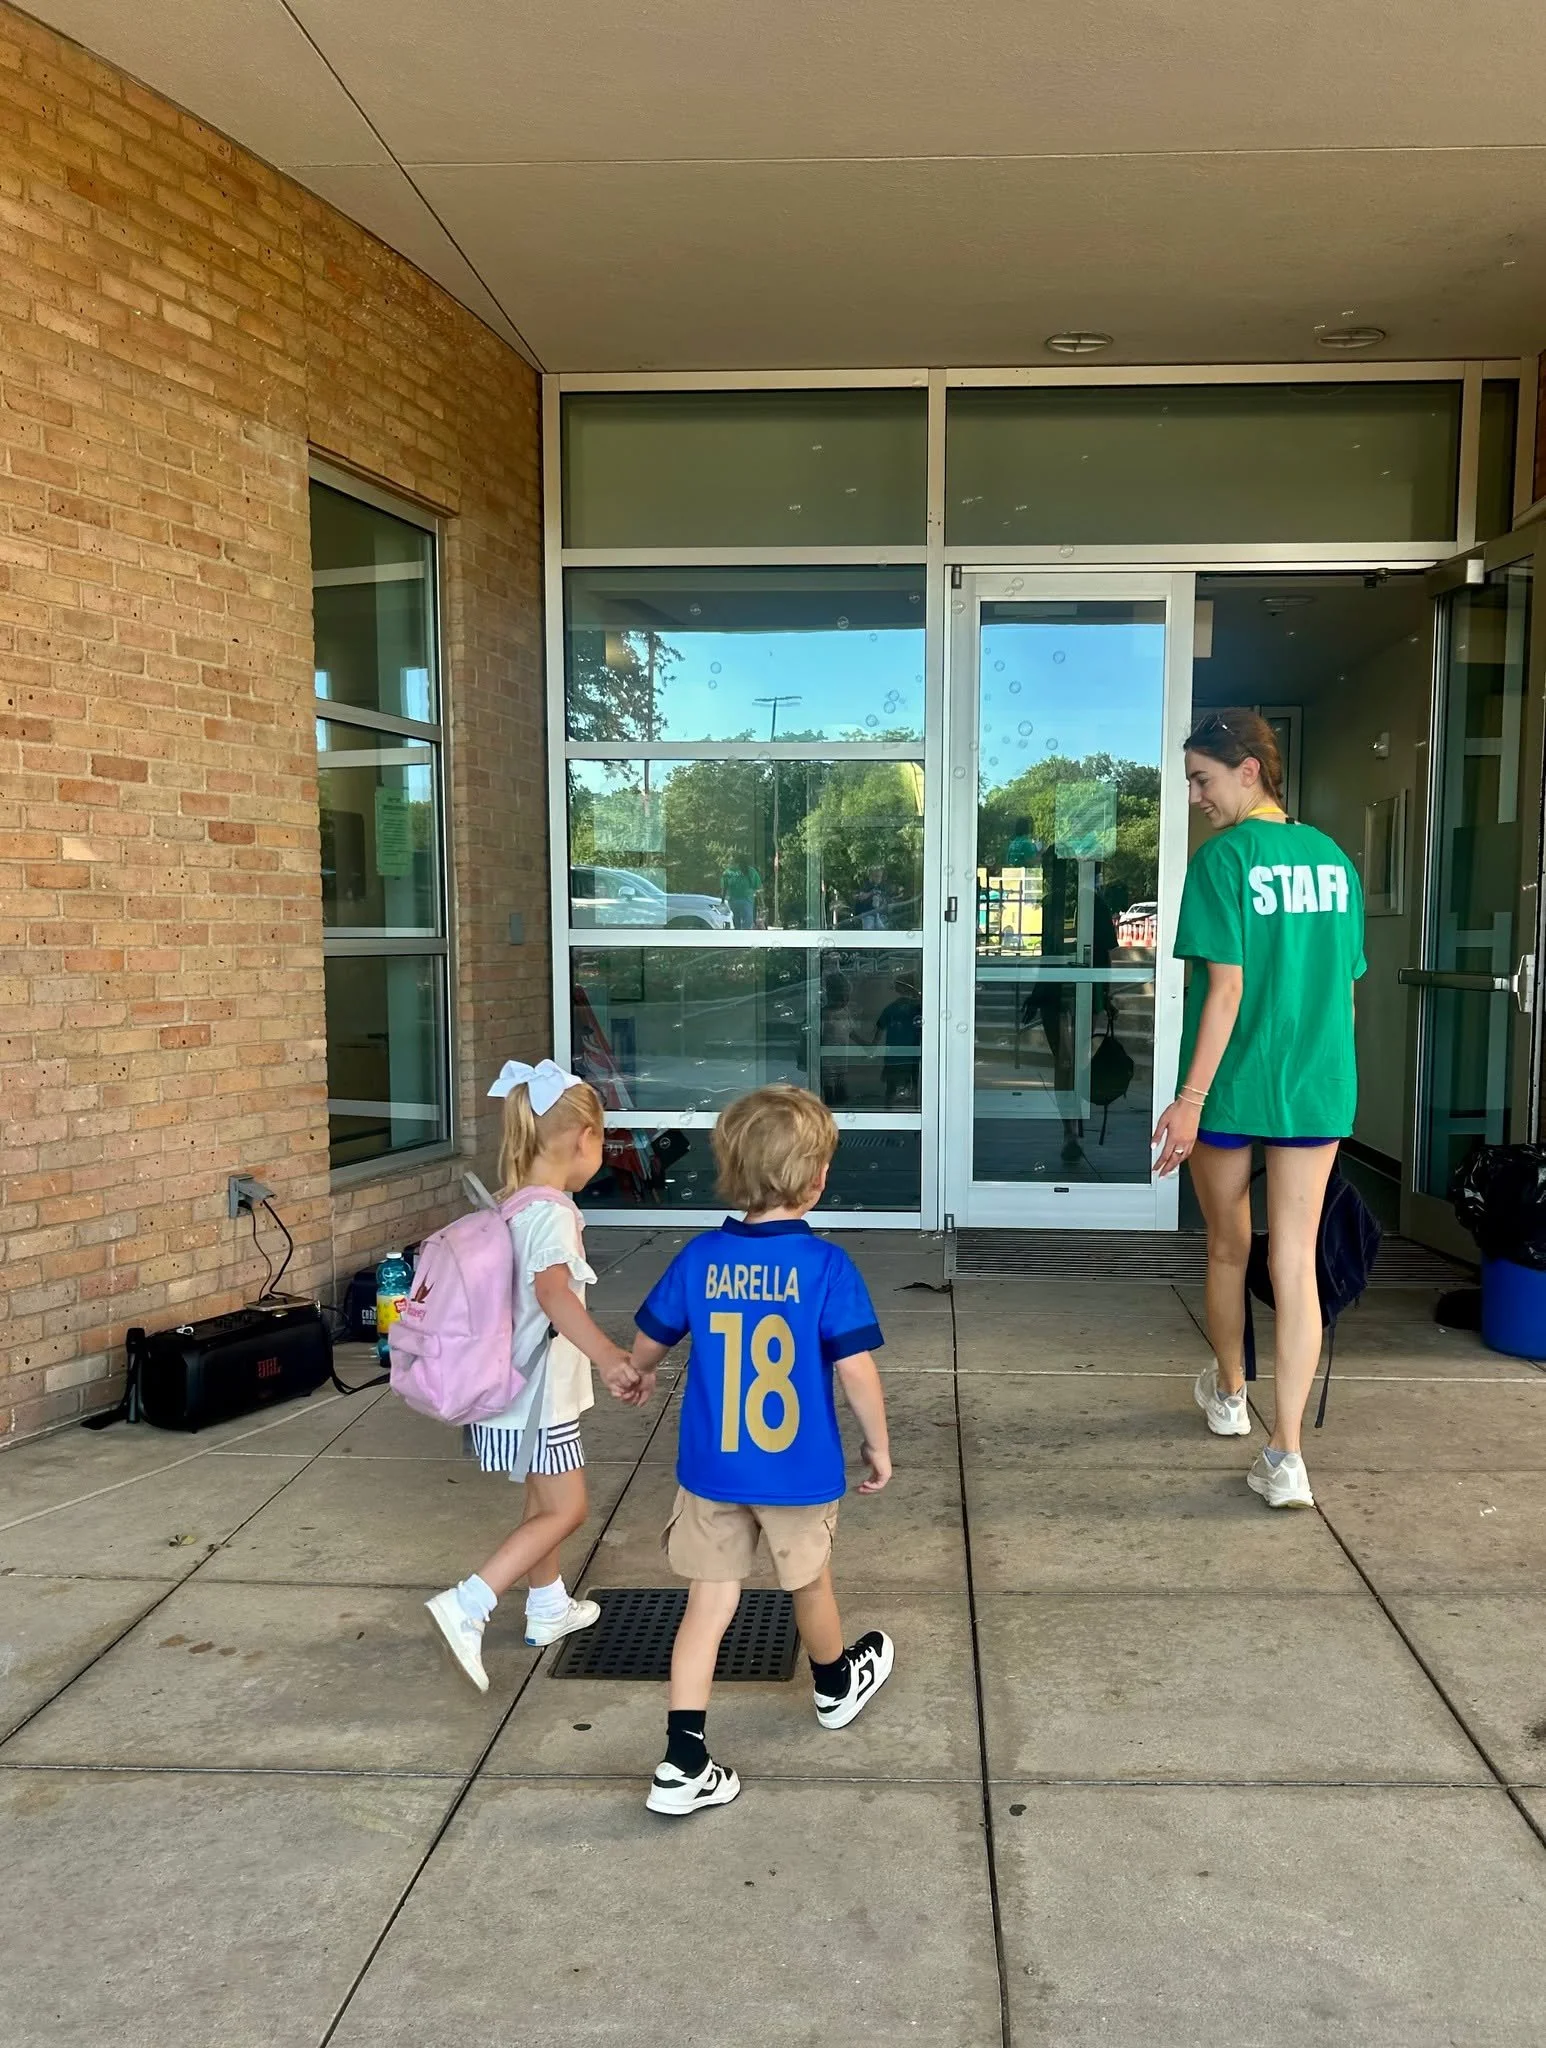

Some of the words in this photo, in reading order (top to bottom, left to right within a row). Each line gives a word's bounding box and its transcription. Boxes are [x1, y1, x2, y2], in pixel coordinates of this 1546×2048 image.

[705, 1263, 800, 1304] BARELLA
[257, 1357, 281, 1379] JBL
[710, 1311, 800, 1453] 18
